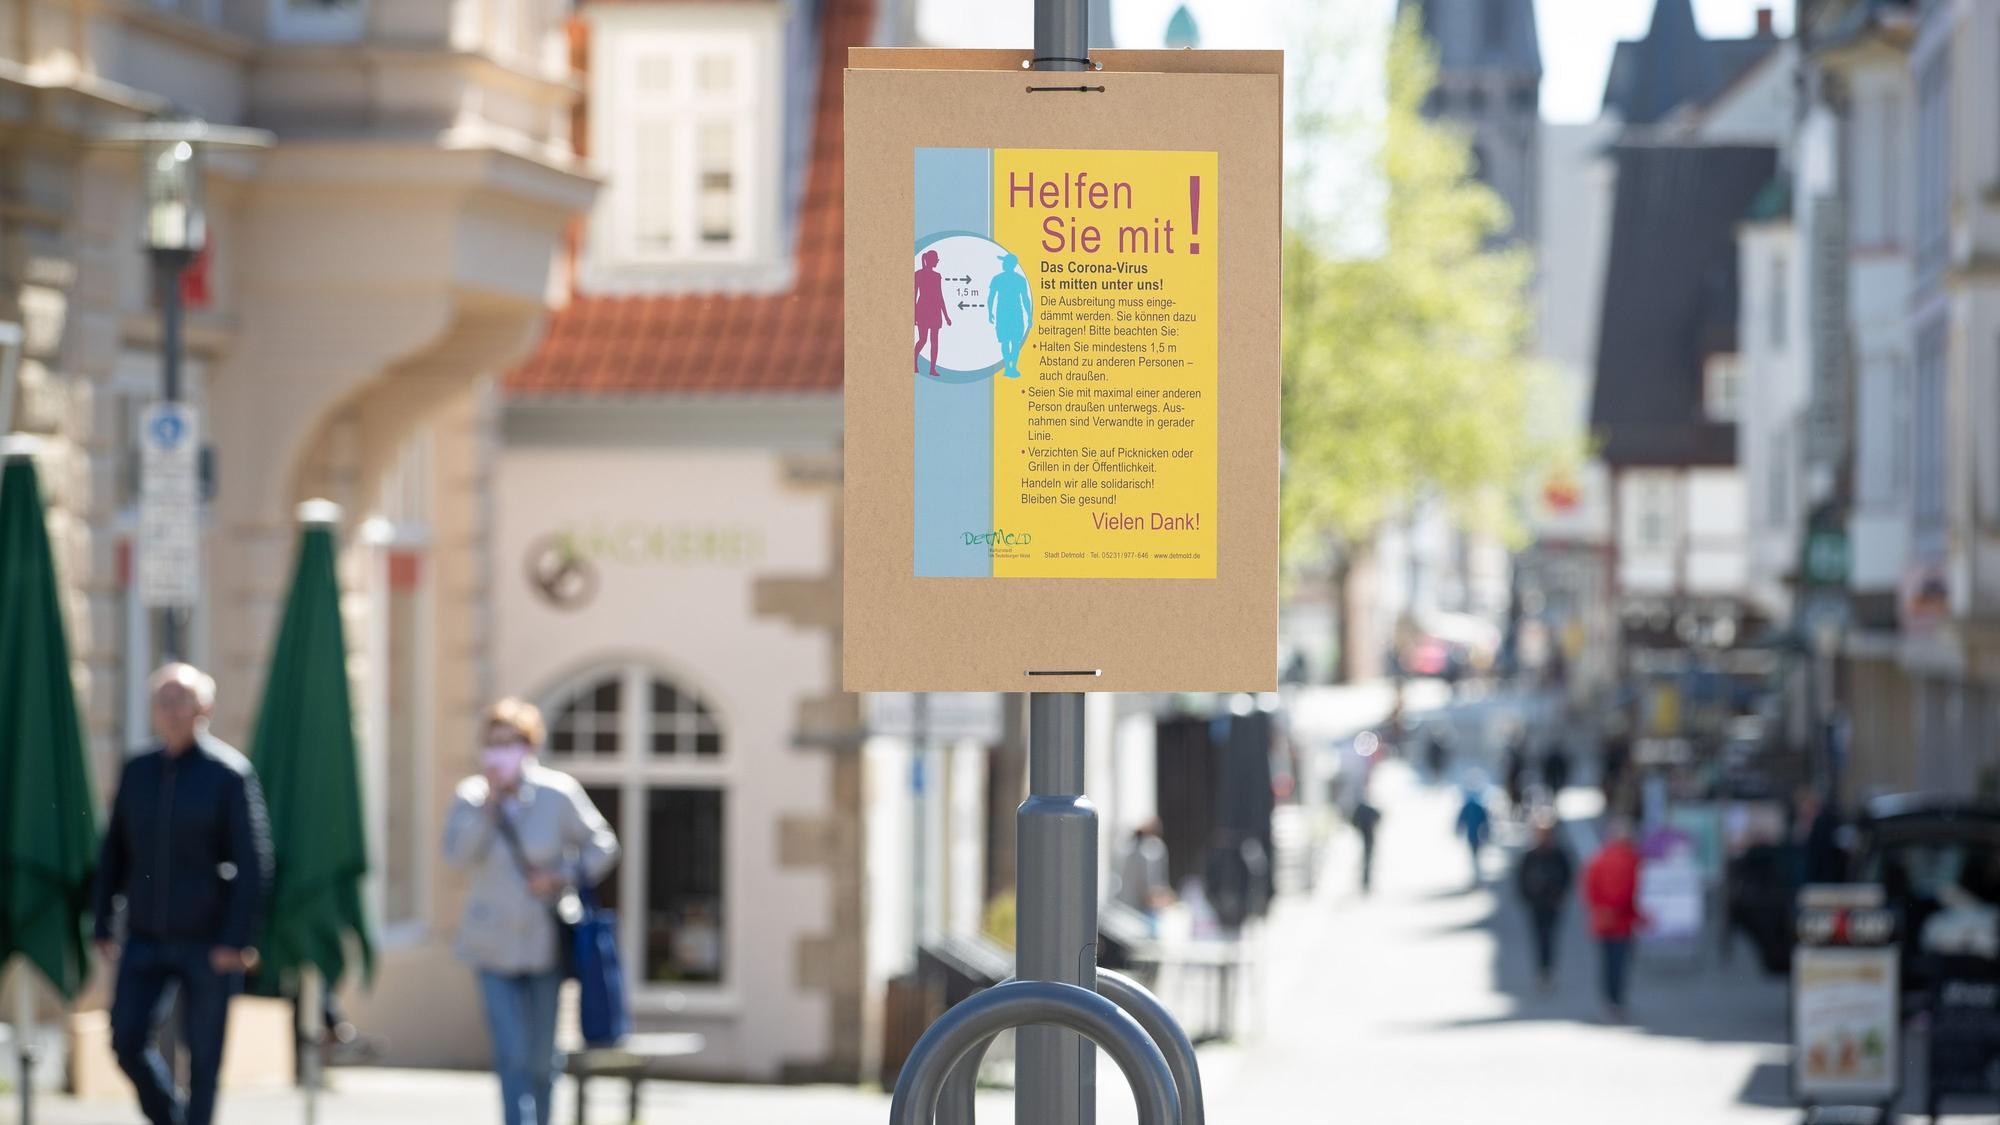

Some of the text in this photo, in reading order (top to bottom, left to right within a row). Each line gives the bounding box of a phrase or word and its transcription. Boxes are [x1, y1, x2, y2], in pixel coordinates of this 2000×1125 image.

[1010, 172, 1131, 209] Helfen
[1041, 216, 1100, 253] Sie
[1119, 218, 1175, 253] mit
[1041, 261, 1148, 273] Das Corona-Virus
[1041, 278, 1163, 290] ist mitten unter uns!
[957, 288, 968, 296] 1,5
[1041, 296, 1176, 309] Die Ausbreitung muss einge-
[1041, 310, 1196, 321] dämmt werden. Sie können dazu
[1039, 325, 1179, 337] beitragen! Bitte beachten Sie:
[1040, 341, 1070, 351] Halten
[1074, 342, 1089, 352] Sie
[1092, 342, 1147, 352] mindestens
[1151, 342, 1165, 353] 1,5
[1040, 356, 1078, 366] Abstand
[1096, 357, 1135, 366] anderen
[1139, 357, 1184, 367] Personen
[1040, 371, 1108, 381] auch draußen.
[1029, 386, 1201, 398] Seien Sie mit maximal einer anderen
[1029, 402, 1185, 415] Person draußen unterwegs. Aus-
[1029, 416, 1195, 429] nahmen sind Verwandte in gerader
[1028, 430, 1053, 440] Linie.
[1028, 447, 1193, 458] Verzichten Sie auf Picknicken oder
[1028, 460, 1156, 472] Grillen in der Öffentlichkeit.
[1022, 478, 1154, 489] Handeln wir alle solidarisch!
[1022, 494, 1117, 507] Bleiben Sie gesund!
[1093, 512, 1199, 530] Vielen Dank!
